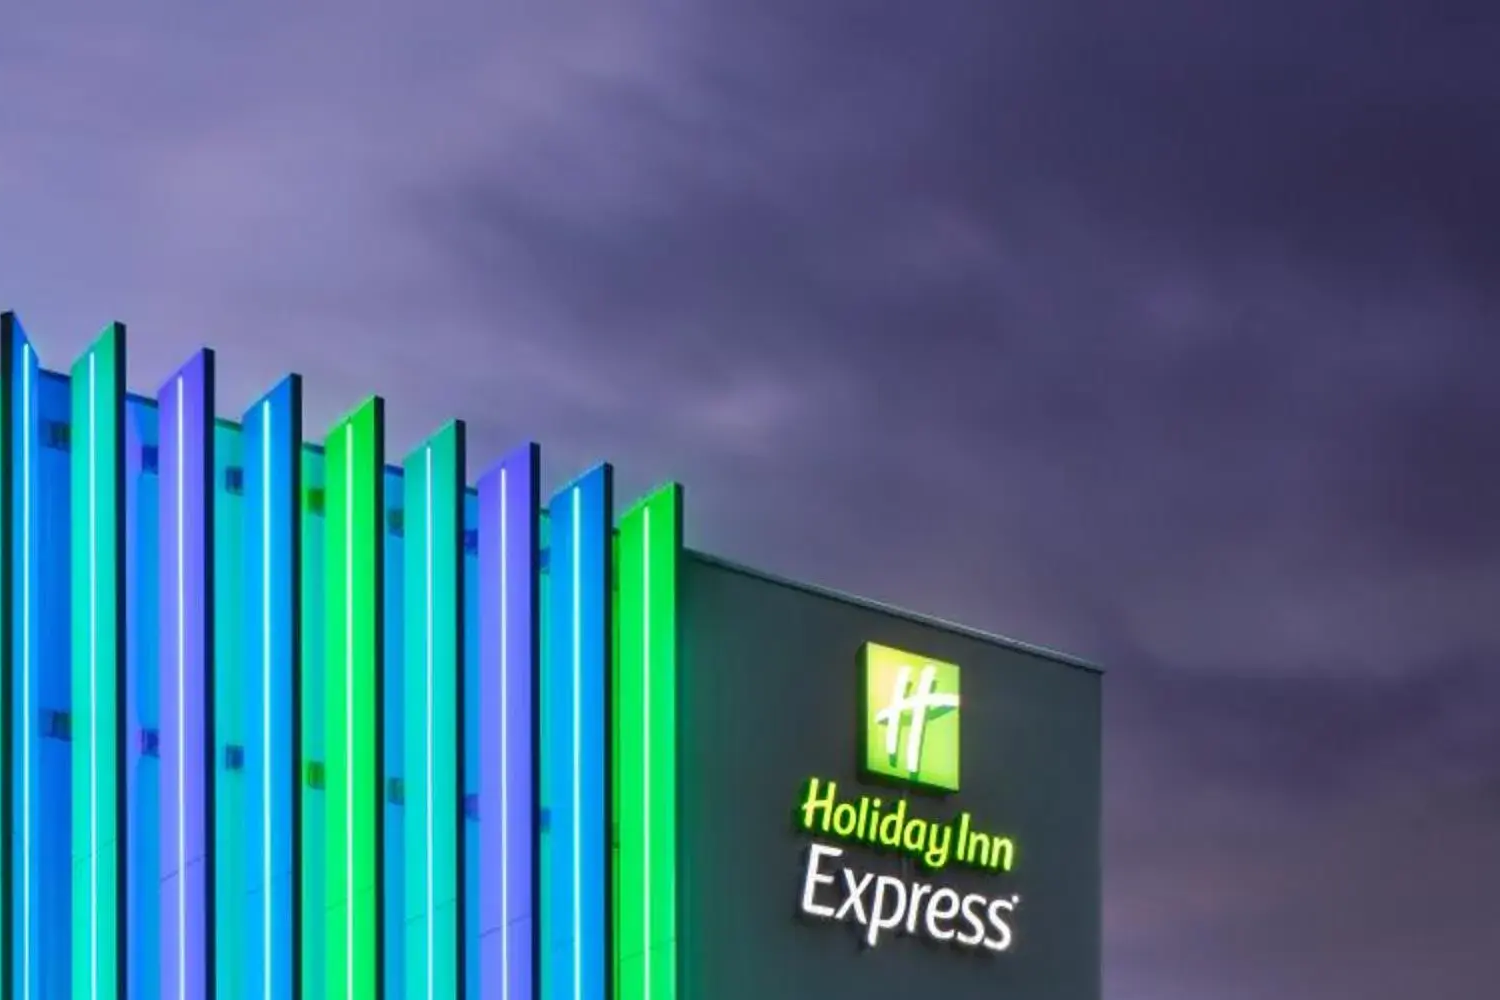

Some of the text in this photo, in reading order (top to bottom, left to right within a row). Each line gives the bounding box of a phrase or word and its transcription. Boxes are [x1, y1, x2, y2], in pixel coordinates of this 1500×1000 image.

[802, 778, 1014, 871] Holiday Inn
[802, 843, 1015, 951] Express
